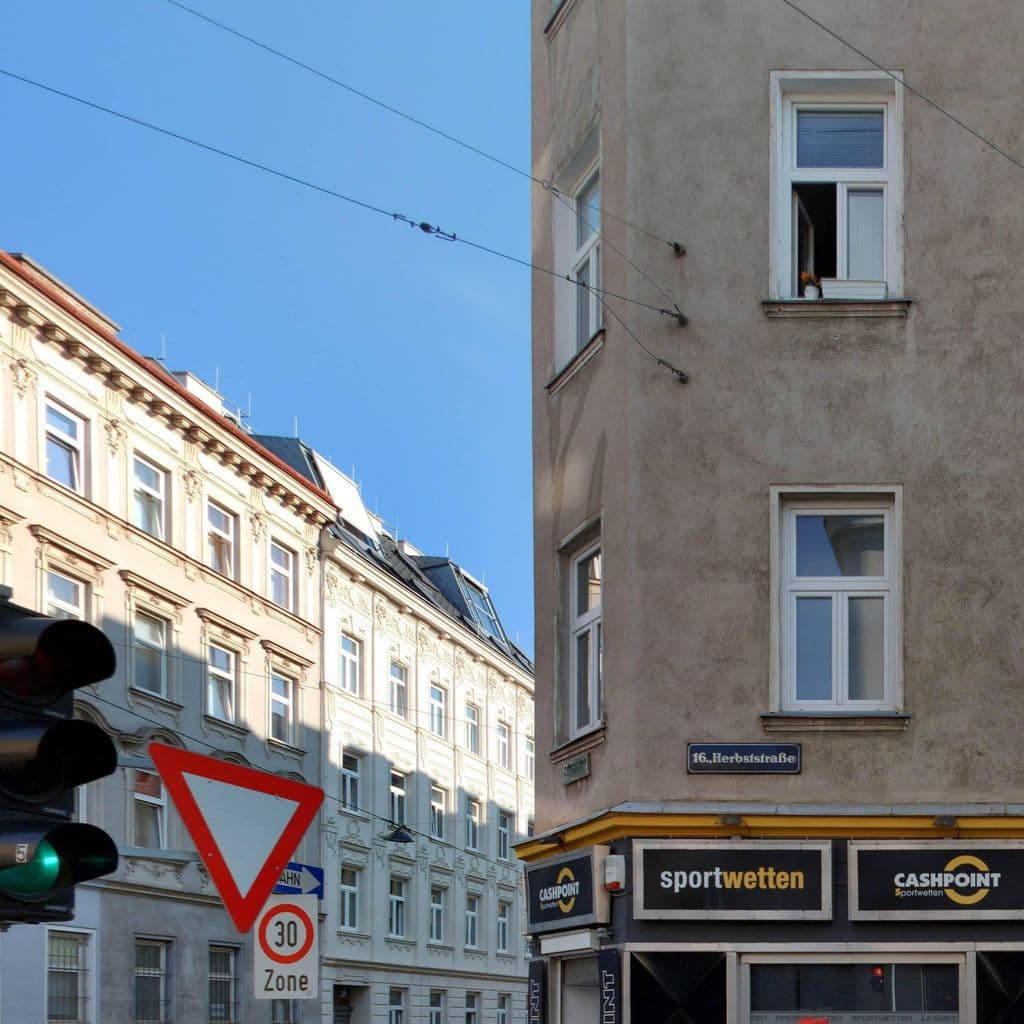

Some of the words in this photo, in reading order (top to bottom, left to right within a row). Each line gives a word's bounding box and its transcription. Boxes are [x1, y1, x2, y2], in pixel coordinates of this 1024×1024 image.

[279, 870, 301, 887] AHN
[660, 865, 805, 893] sportwetten
[894, 872, 1001, 888] CASHPOINT
[539, 882, 580, 901] CASHPOINT
[895, 887, 944, 898] Sportwetten
[274, 920, 298, 947] 30
[264, 968, 308, 991] Zone
